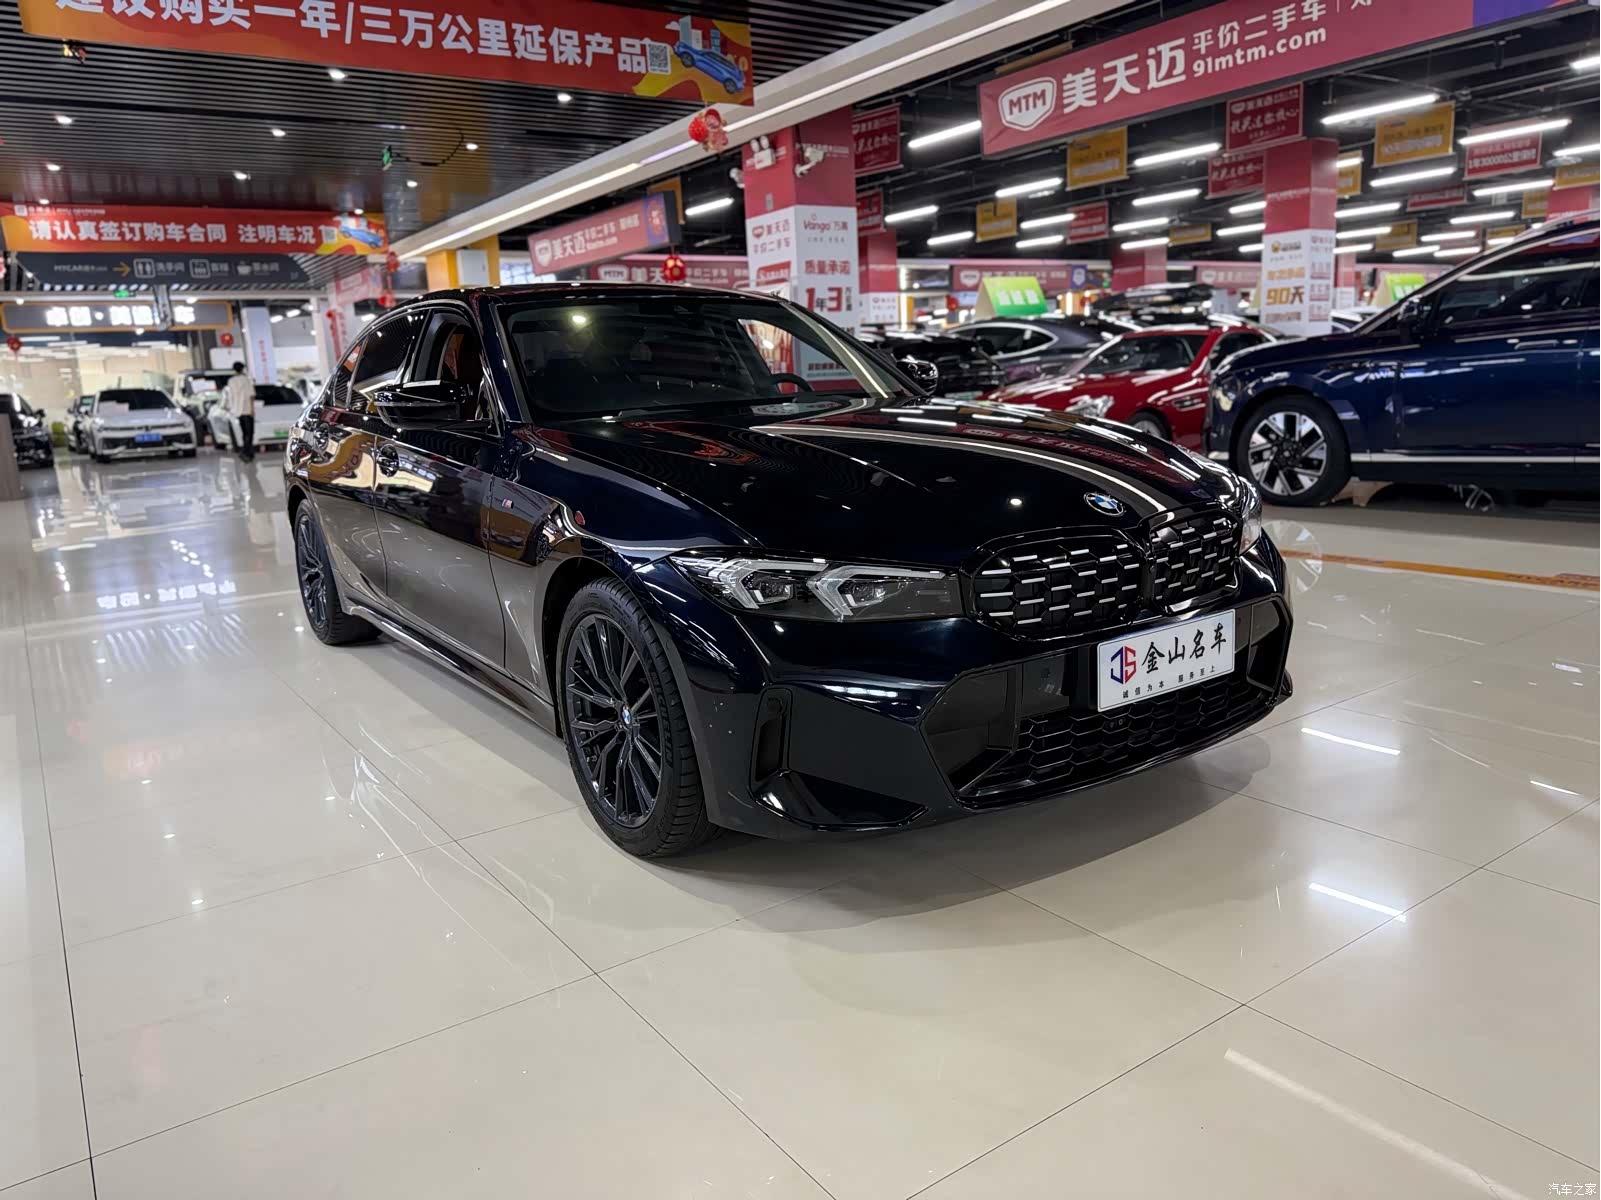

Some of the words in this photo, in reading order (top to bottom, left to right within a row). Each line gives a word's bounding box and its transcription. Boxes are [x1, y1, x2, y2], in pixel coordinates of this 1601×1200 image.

[1191, 0, 1327, 55] 平价二手车
[1192, 27, 1327, 78] 91mtm.com
[1008, 90, 1047, 117] MTM
[1062, 38, 1187, 114] 美天迈
[29, 220, 227, 243] 请认真签订购车合同
[238, 224, 316, 243] 注明车况
[1267, 286, 1304, 305] 90天
[1142, 622, 1227, 674] 金山名车
